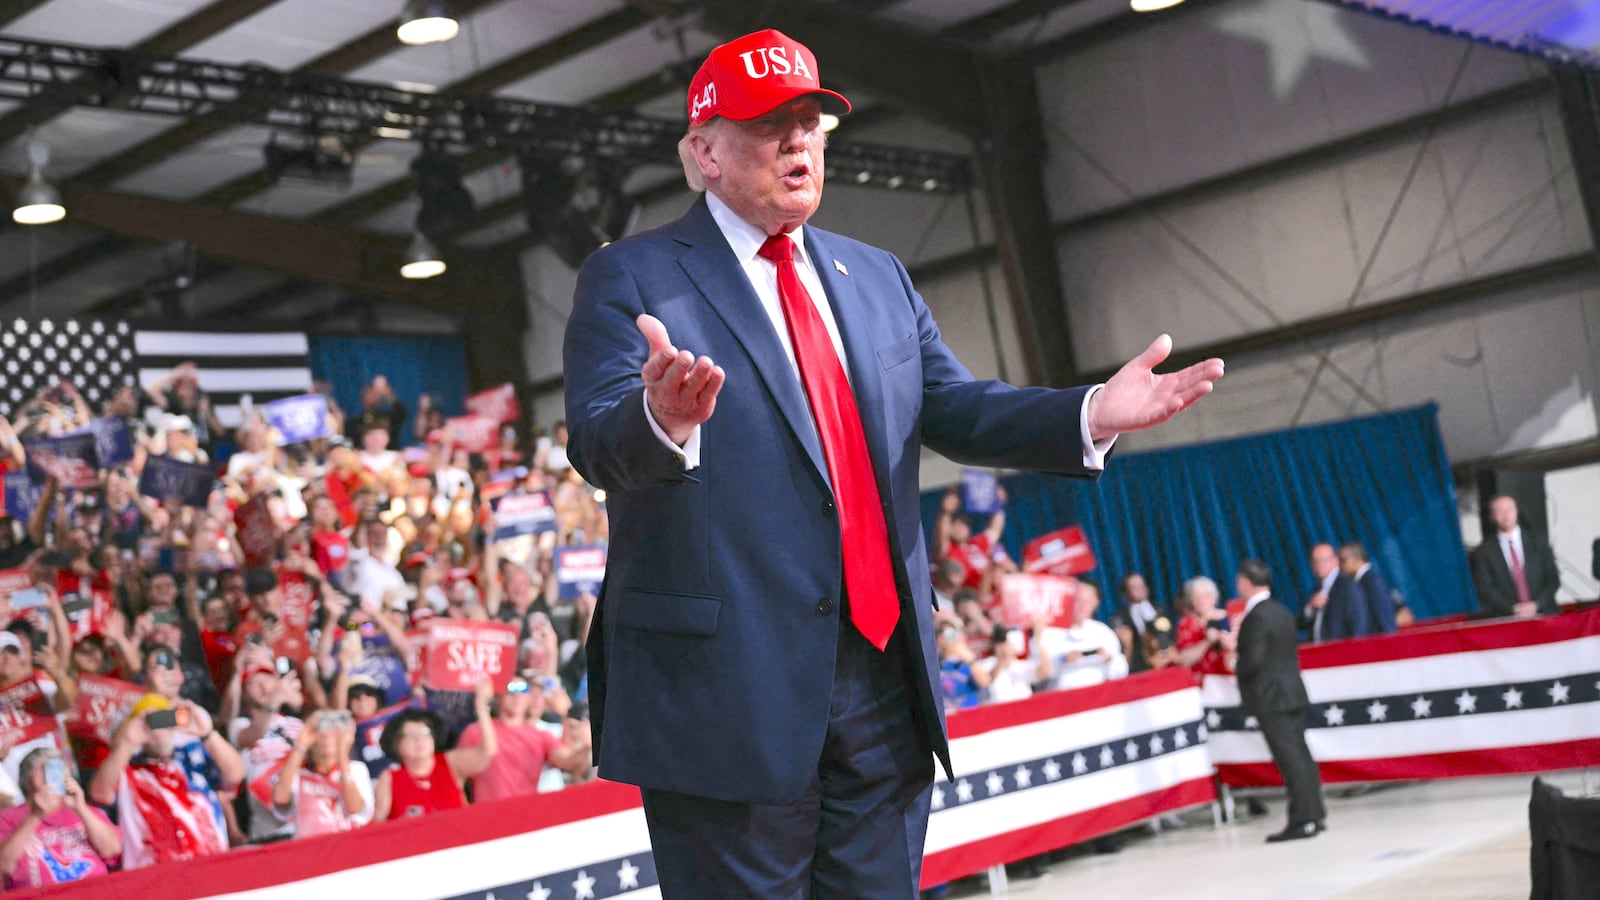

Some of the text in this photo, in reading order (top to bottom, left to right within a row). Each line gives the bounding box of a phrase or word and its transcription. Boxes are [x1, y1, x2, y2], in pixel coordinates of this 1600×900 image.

[739, 46, 813, 81] USA
[446, 640, 503, 674] SAFE
[317, 797, 352, 833] SA
